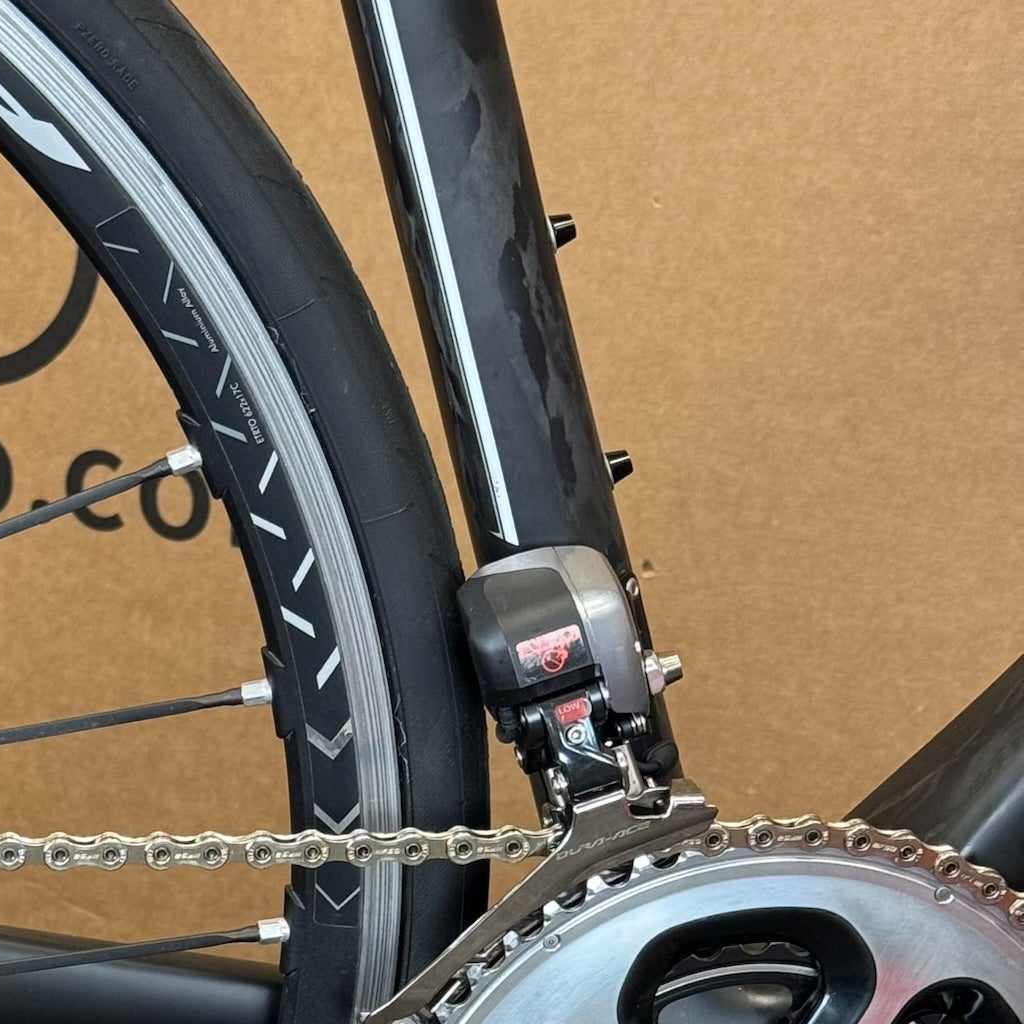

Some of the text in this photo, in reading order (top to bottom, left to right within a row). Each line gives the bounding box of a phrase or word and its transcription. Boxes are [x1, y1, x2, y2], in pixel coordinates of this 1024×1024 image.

[177, 287, 220, 353] Aluminium Alloy
[248, 417, 265, 445] ETRTO
[558, 701, 581, 715] LOW
[556, 820, 652, 861] DURA-ACE
